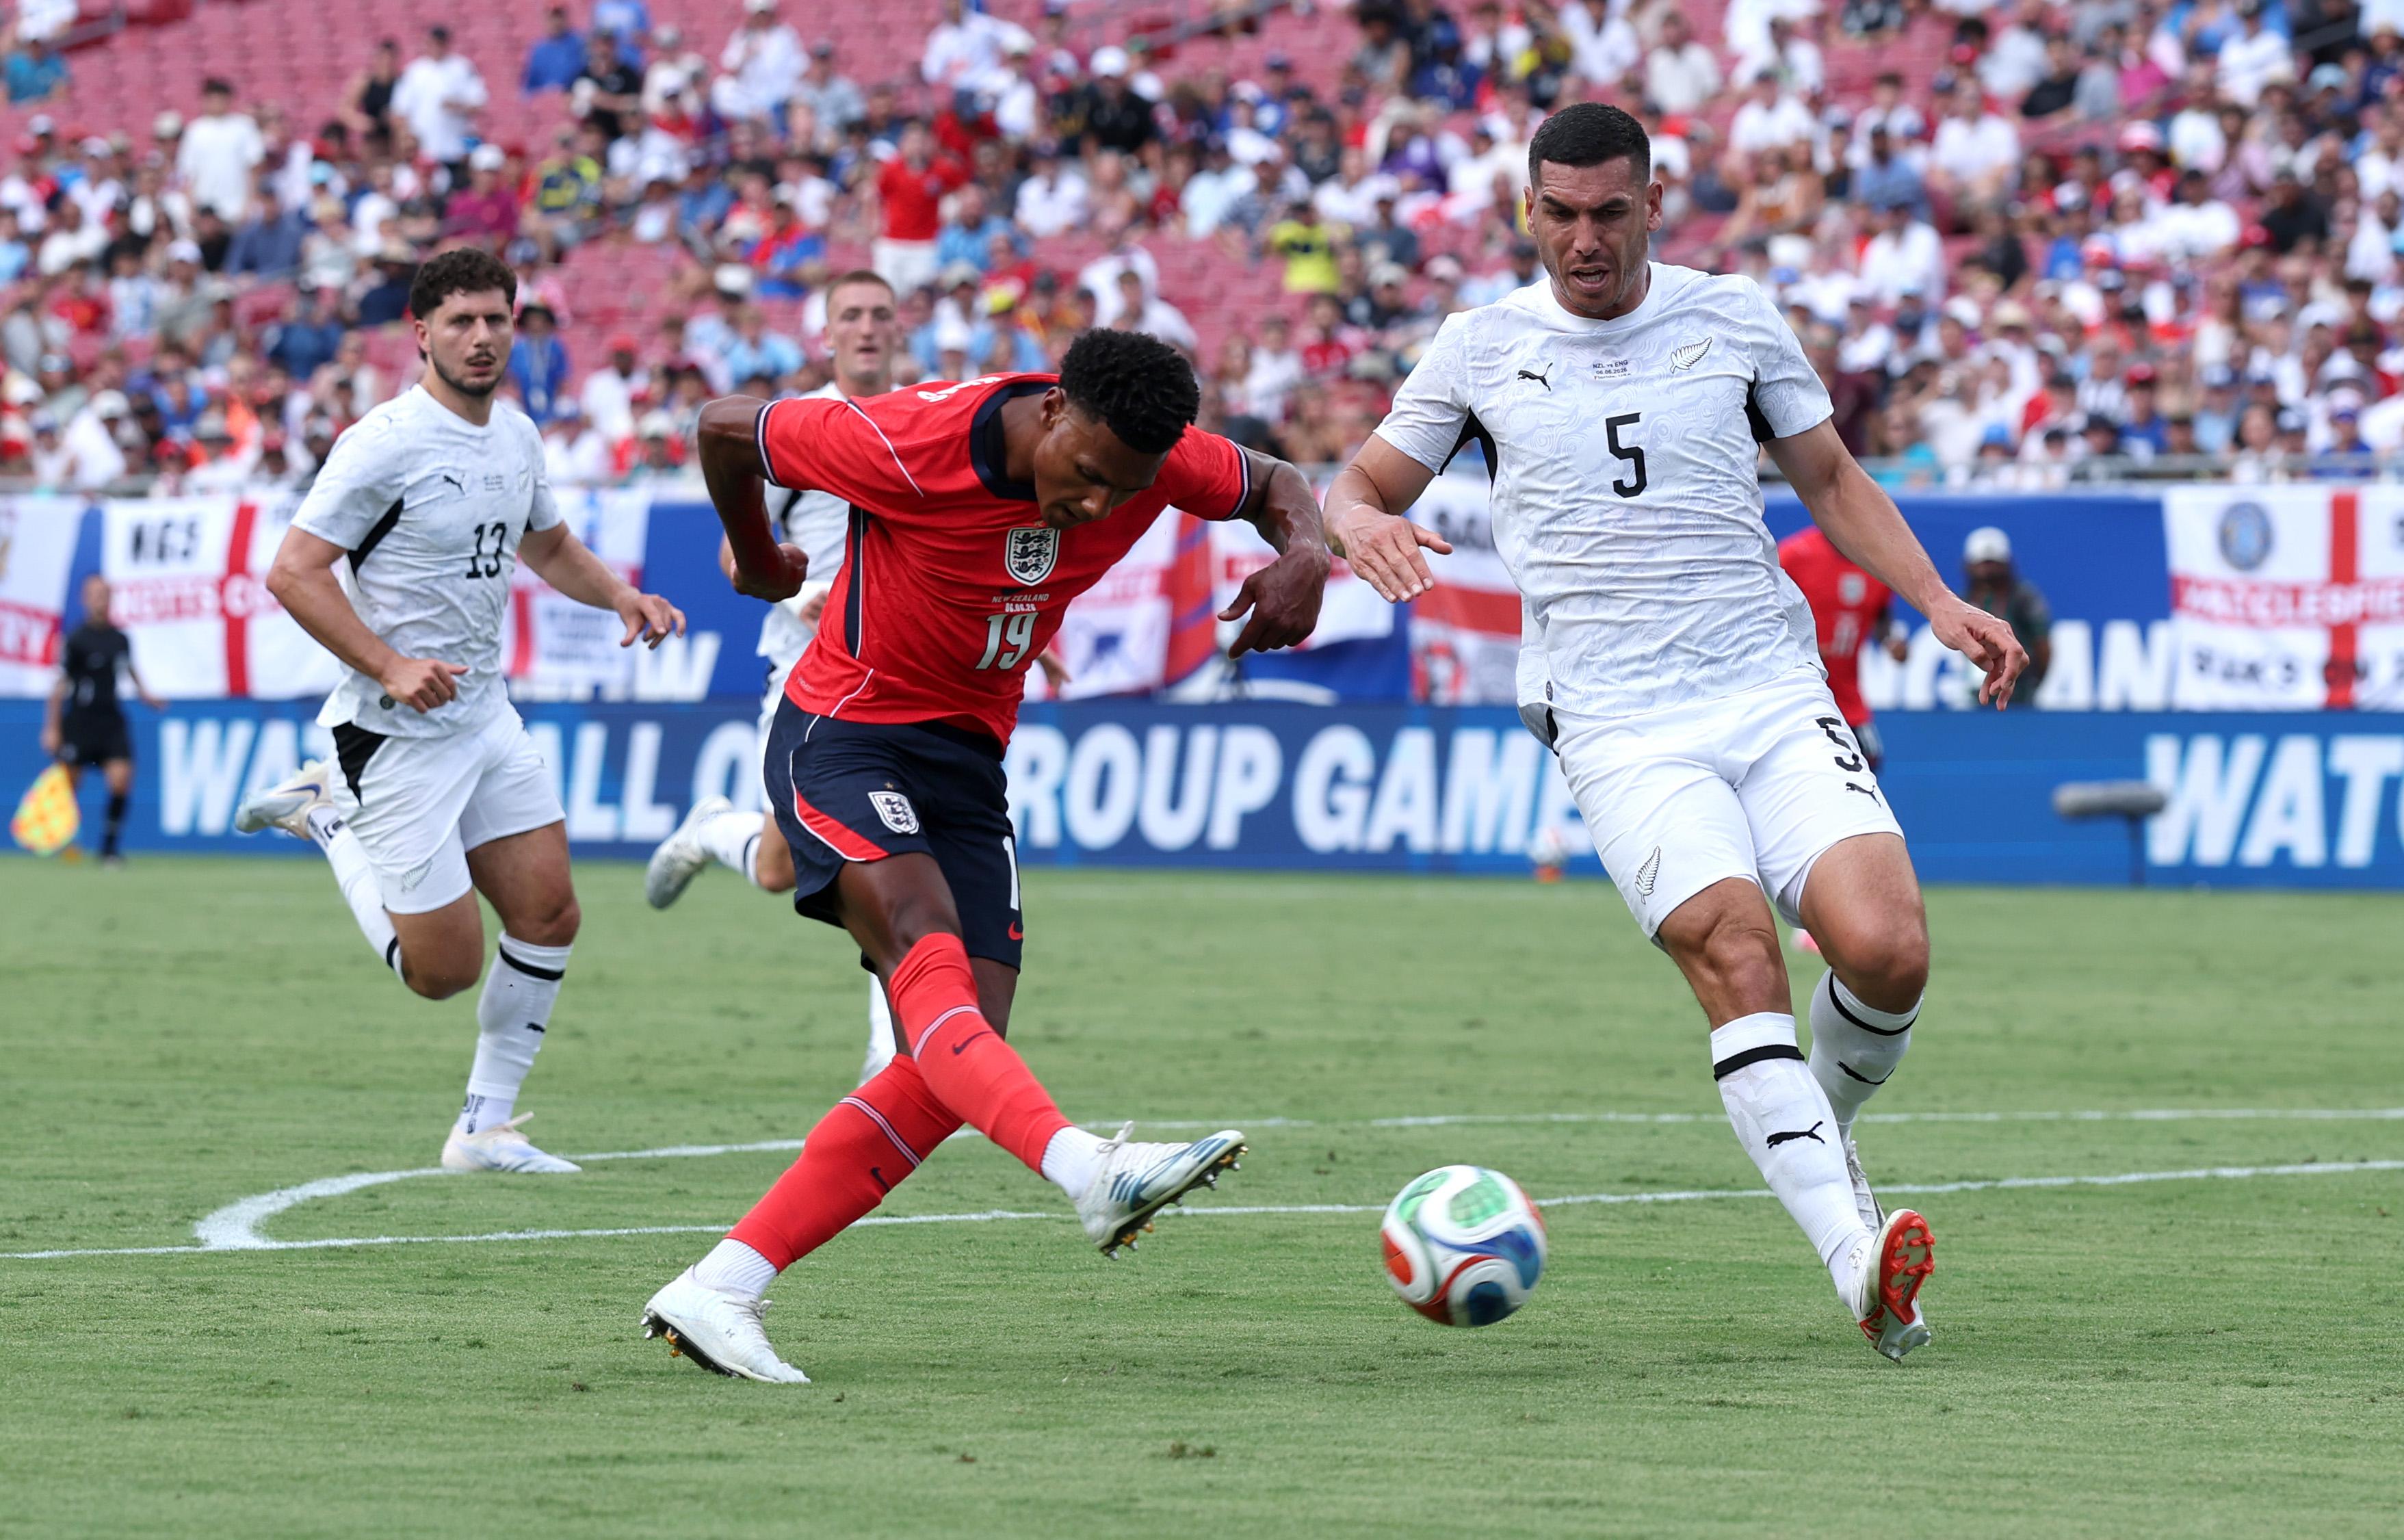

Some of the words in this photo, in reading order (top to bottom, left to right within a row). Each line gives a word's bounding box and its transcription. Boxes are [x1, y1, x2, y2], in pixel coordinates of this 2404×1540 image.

[1615, 359, 1628, 367] ENG
[1606, 412, 1647, 498] 5
[466, 522, 507, 579] 13
[1011, 593, 1049, 602] ZEALAND
[974, 612, 1039, 670] 19
[1814, 717, 1863, 772] 5
[1004, 722, 1285, 852] ROUP
[1290, 722, 1597, 856] GAME
[2144, 733, 2404, 867] WAT
